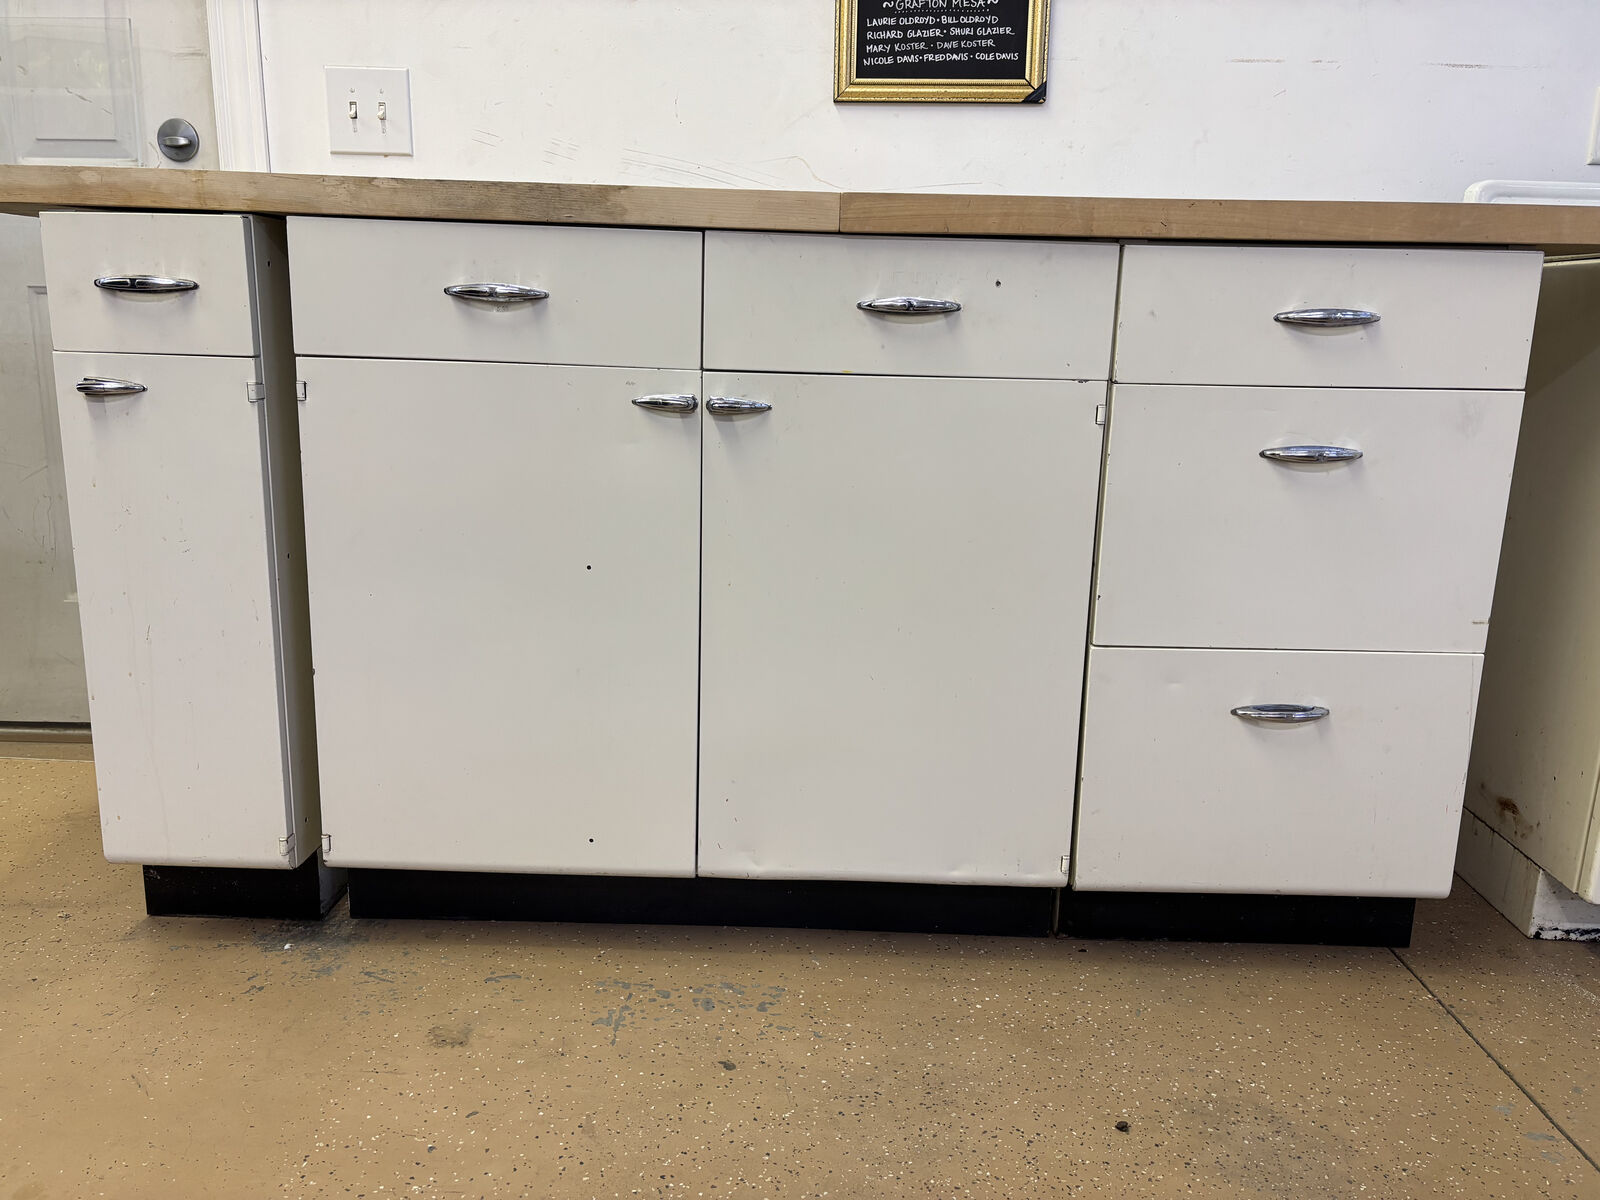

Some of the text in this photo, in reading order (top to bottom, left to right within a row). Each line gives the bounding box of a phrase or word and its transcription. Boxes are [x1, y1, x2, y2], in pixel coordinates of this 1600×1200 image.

[895, 0, 986, 10] GRAFTON MESA
[866, 15, 999, 27] LAURIE OLDROYD BILL OLDROYD
[866, 26, 1015, 40] RICHARD GLAZIER SHURI GLAZIER
[866, 38, 996, 53] MARY KOSTER DAVE KOSTER
[863, 52, 1019, 66] NICOLE DAVIS FRED DAVIS COLE DAVIS
